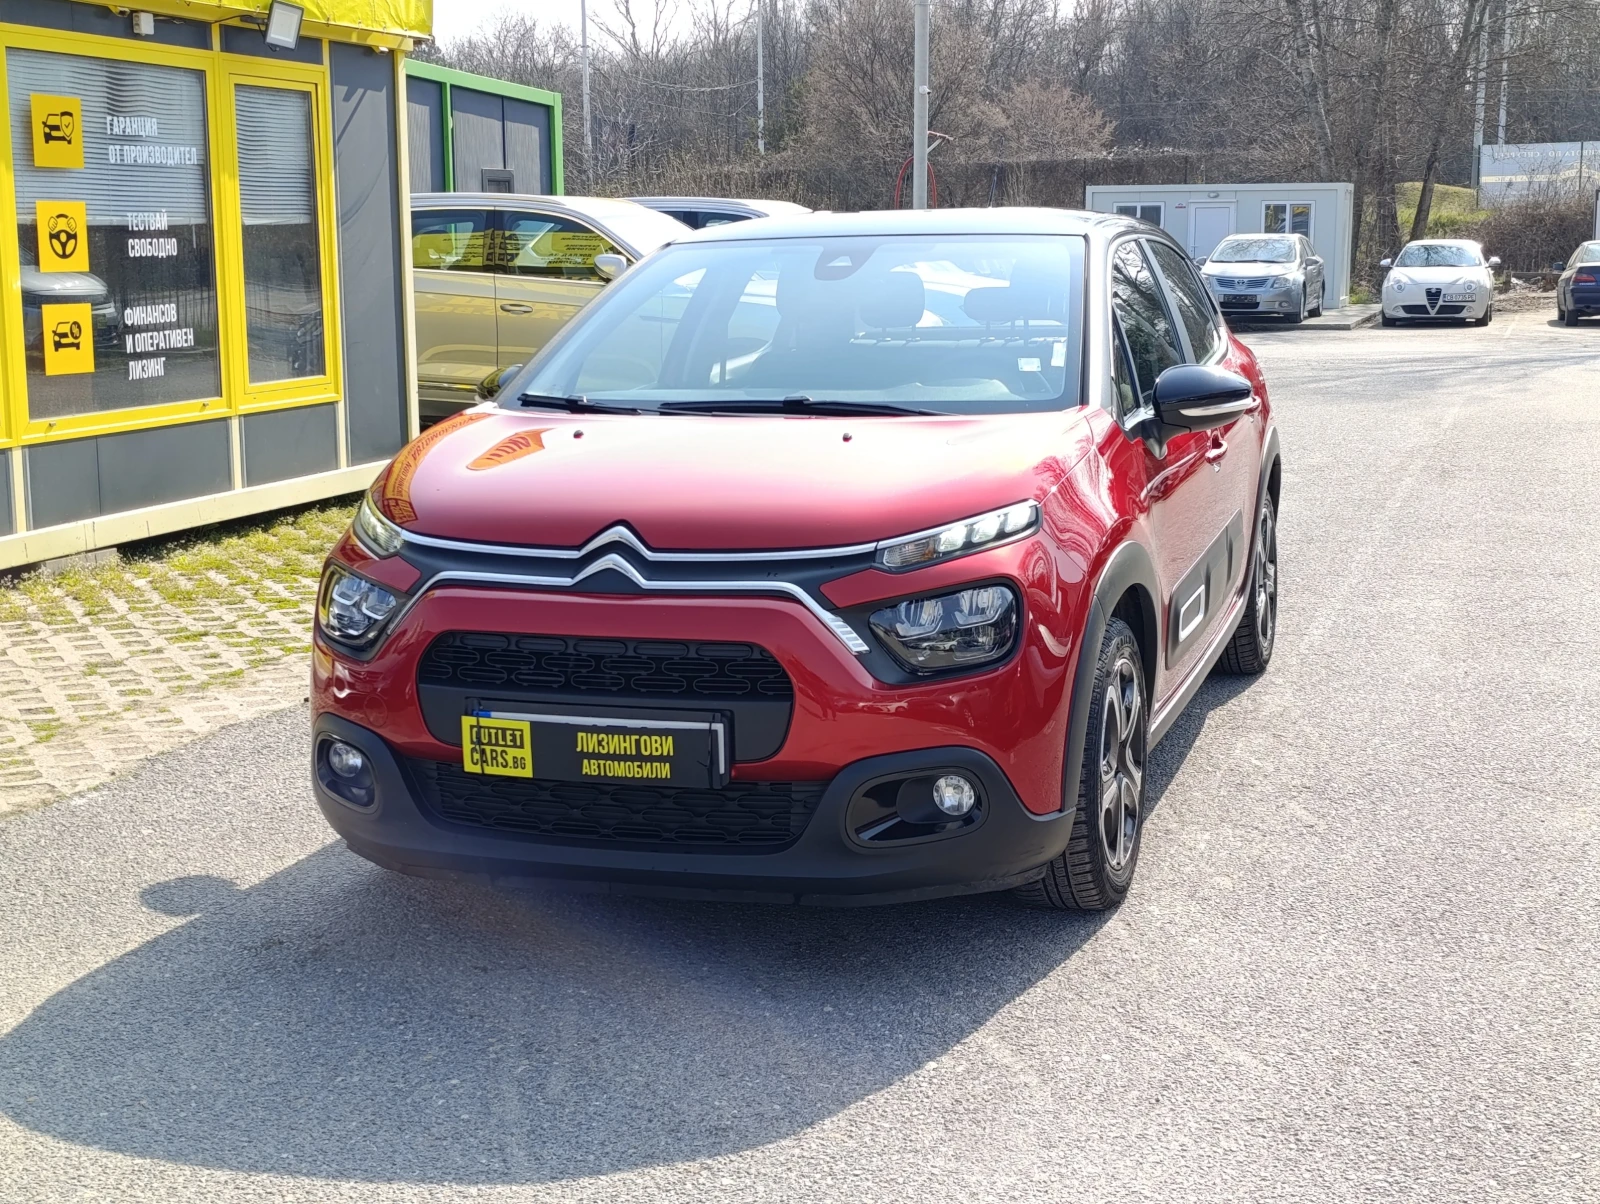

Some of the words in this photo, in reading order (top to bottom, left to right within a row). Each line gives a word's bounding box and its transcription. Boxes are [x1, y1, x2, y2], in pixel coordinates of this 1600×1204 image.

[106, 116, 158, 138] ГАРАНЦИЯ
[108, 145, 123, 164] ОТ
[124, 145, 197, 166] ПРОИЗВОДИТЕЛ
[127, 209, 168, 231] ТЕСТВАЙ
[128, 238, 178, 258] СВОБОДНО
[124, 303, 178, 327] ФИНАНСОВ
[126, 335, 134, 354] И
[135, 328, 194, 352] ОПЕРАТИВЕН
[128, 357, 167, 381] ЛИЗИНГ
[472, 727, 522, 746] OUTLET
[576, 732, 674, 757] ЛИЗИНГОВИ
[470, 746, 527, 771] CARS.BG
[582, 758, 671, 779] АВТОМОБИЛИ
